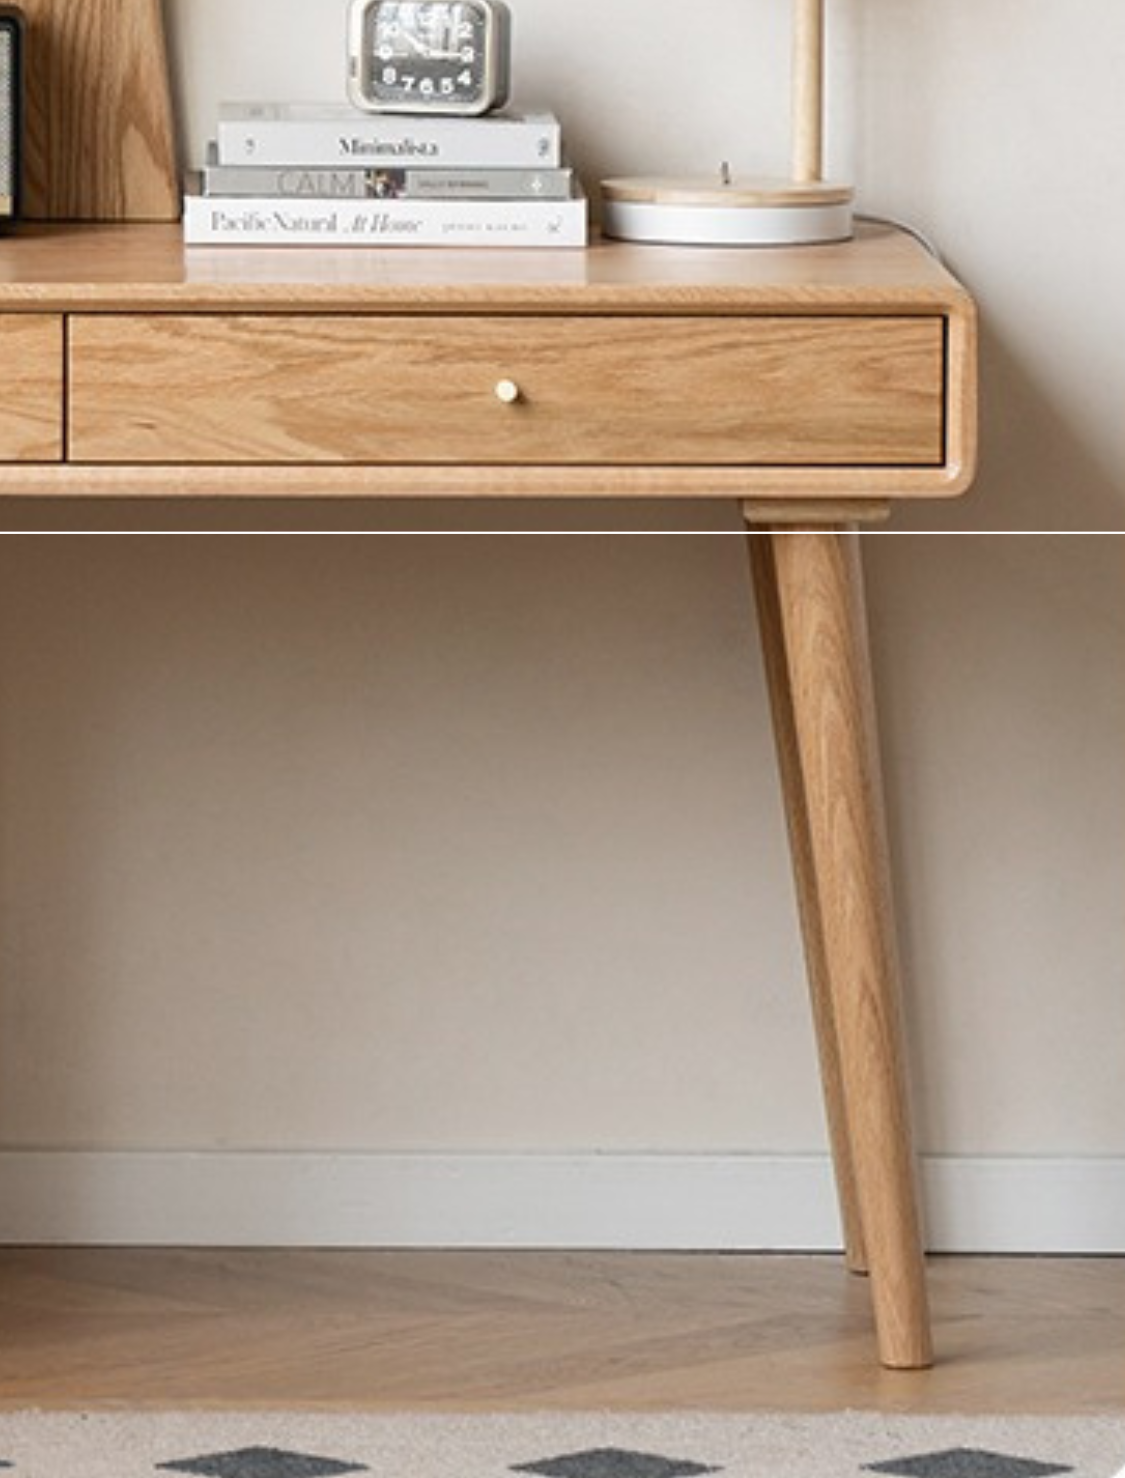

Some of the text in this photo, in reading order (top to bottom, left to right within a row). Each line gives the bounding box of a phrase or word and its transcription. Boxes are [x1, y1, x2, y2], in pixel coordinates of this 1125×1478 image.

[400, 75, 416, 92] 7
[418, 76, 434, 95] 6
[439, 76, 455, 95] 5
[338, 137, 440, 156] Minimalista
[277, 172, 357, 196] CALM
[211, 210, 271, 232] Pacific
[272, 210, 338, 232] Natural
